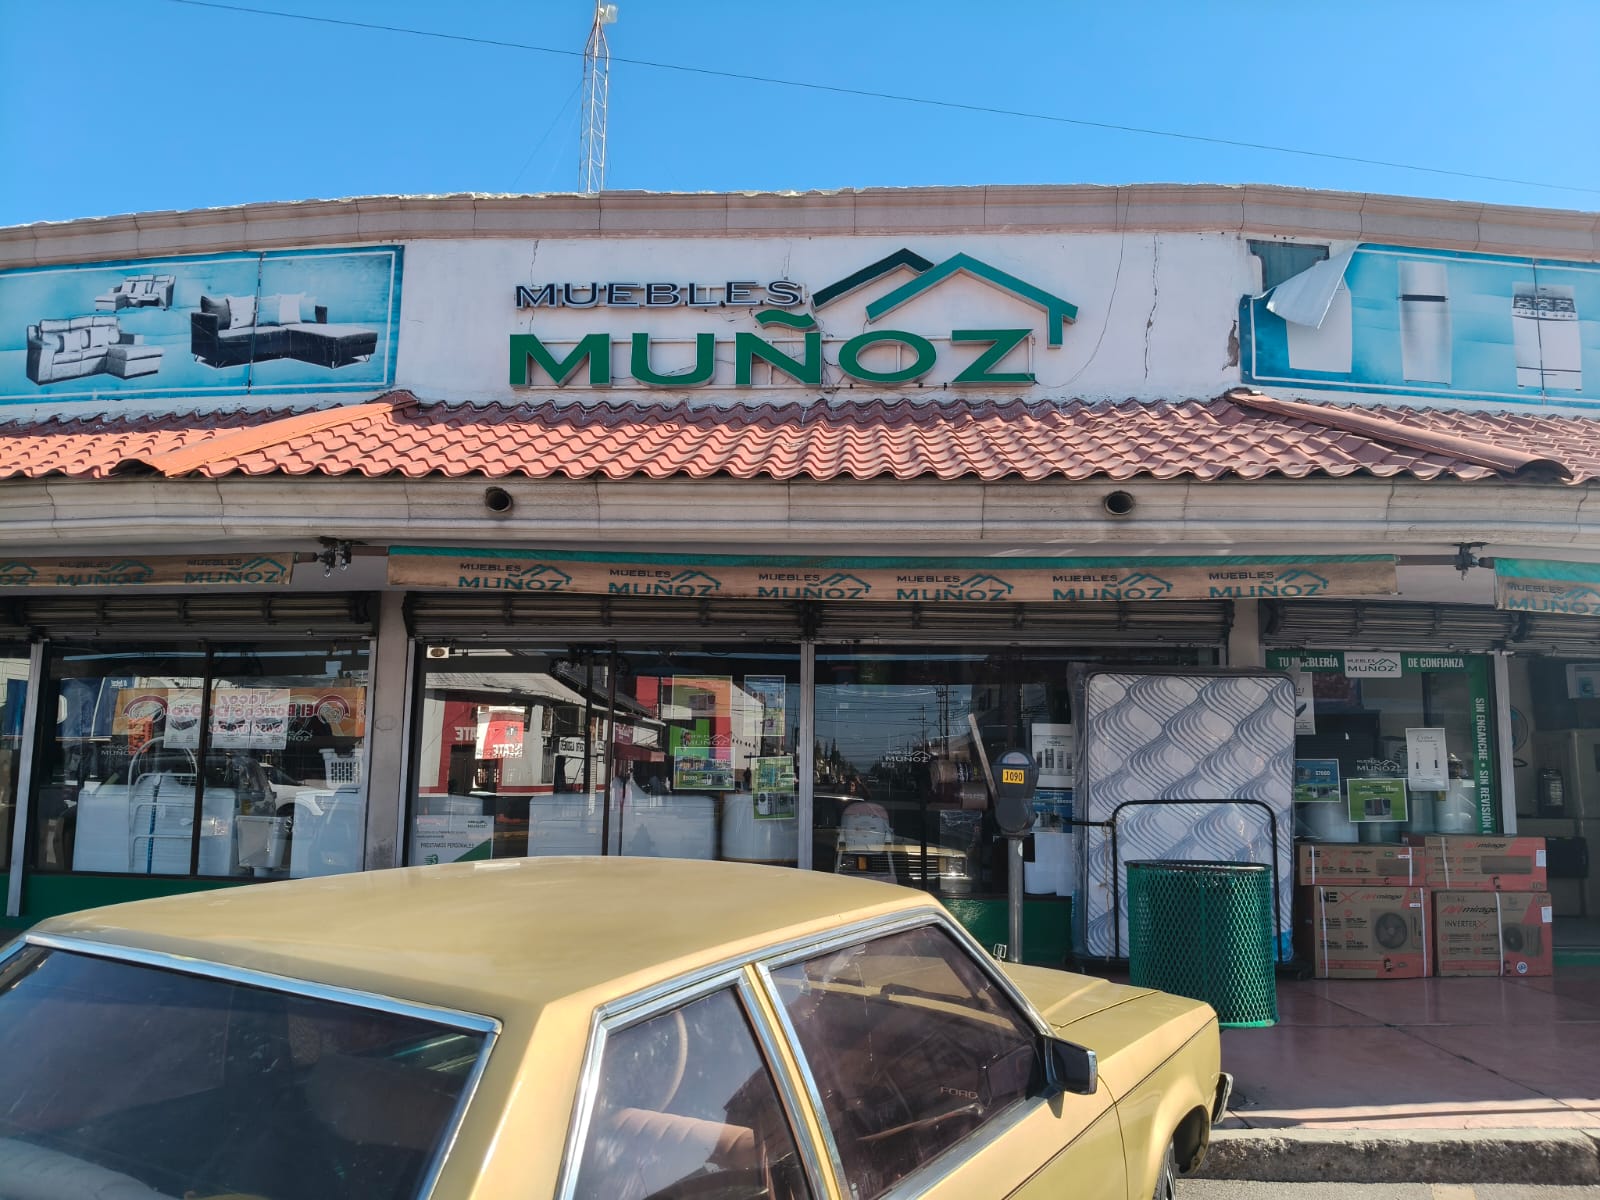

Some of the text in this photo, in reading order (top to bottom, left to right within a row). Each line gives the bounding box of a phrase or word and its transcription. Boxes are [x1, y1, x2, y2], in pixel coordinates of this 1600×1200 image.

[515, 281, 801, 308] MUEBLES
[509, 309, 1036, 386] MUÑOZ
[460, 563, 521, 573] MUEBLES
[609, 568, 672, 578] MUEBLES
[458, 573, 564, 591] MUÑOZ
[758, 573, 821, 582] MUEBLES
[896, 575, 961, 583] MUEBLES
[1052, 574, 1118, 582] MUEBLES
[1208, 571, 1274, 580] MUEBLES
[608, 579, 713, 597] MUÑOZ
[758, 583, 864, 600] MUÑOZ
[896, 584, 1009, 601] MUÑOZ
[1053, 583, 1165, 601] MUÑOZ
[1209, 580, 1321, 598] MUÑOZ
[1278, 656, 1289, 667] TU
[1347, 663, 1395, 672] MUÑOZ
[1408, 657, 1464, 668] DE CONFIANZA
[1475, 697, 1488, 760] SIN ENGANCHE
[1004, 771, 1023, 782] 1090
[1479, 770, 1493, 827] SIN REVISIÓN
[940, 1086, 978, 1100] FORD
